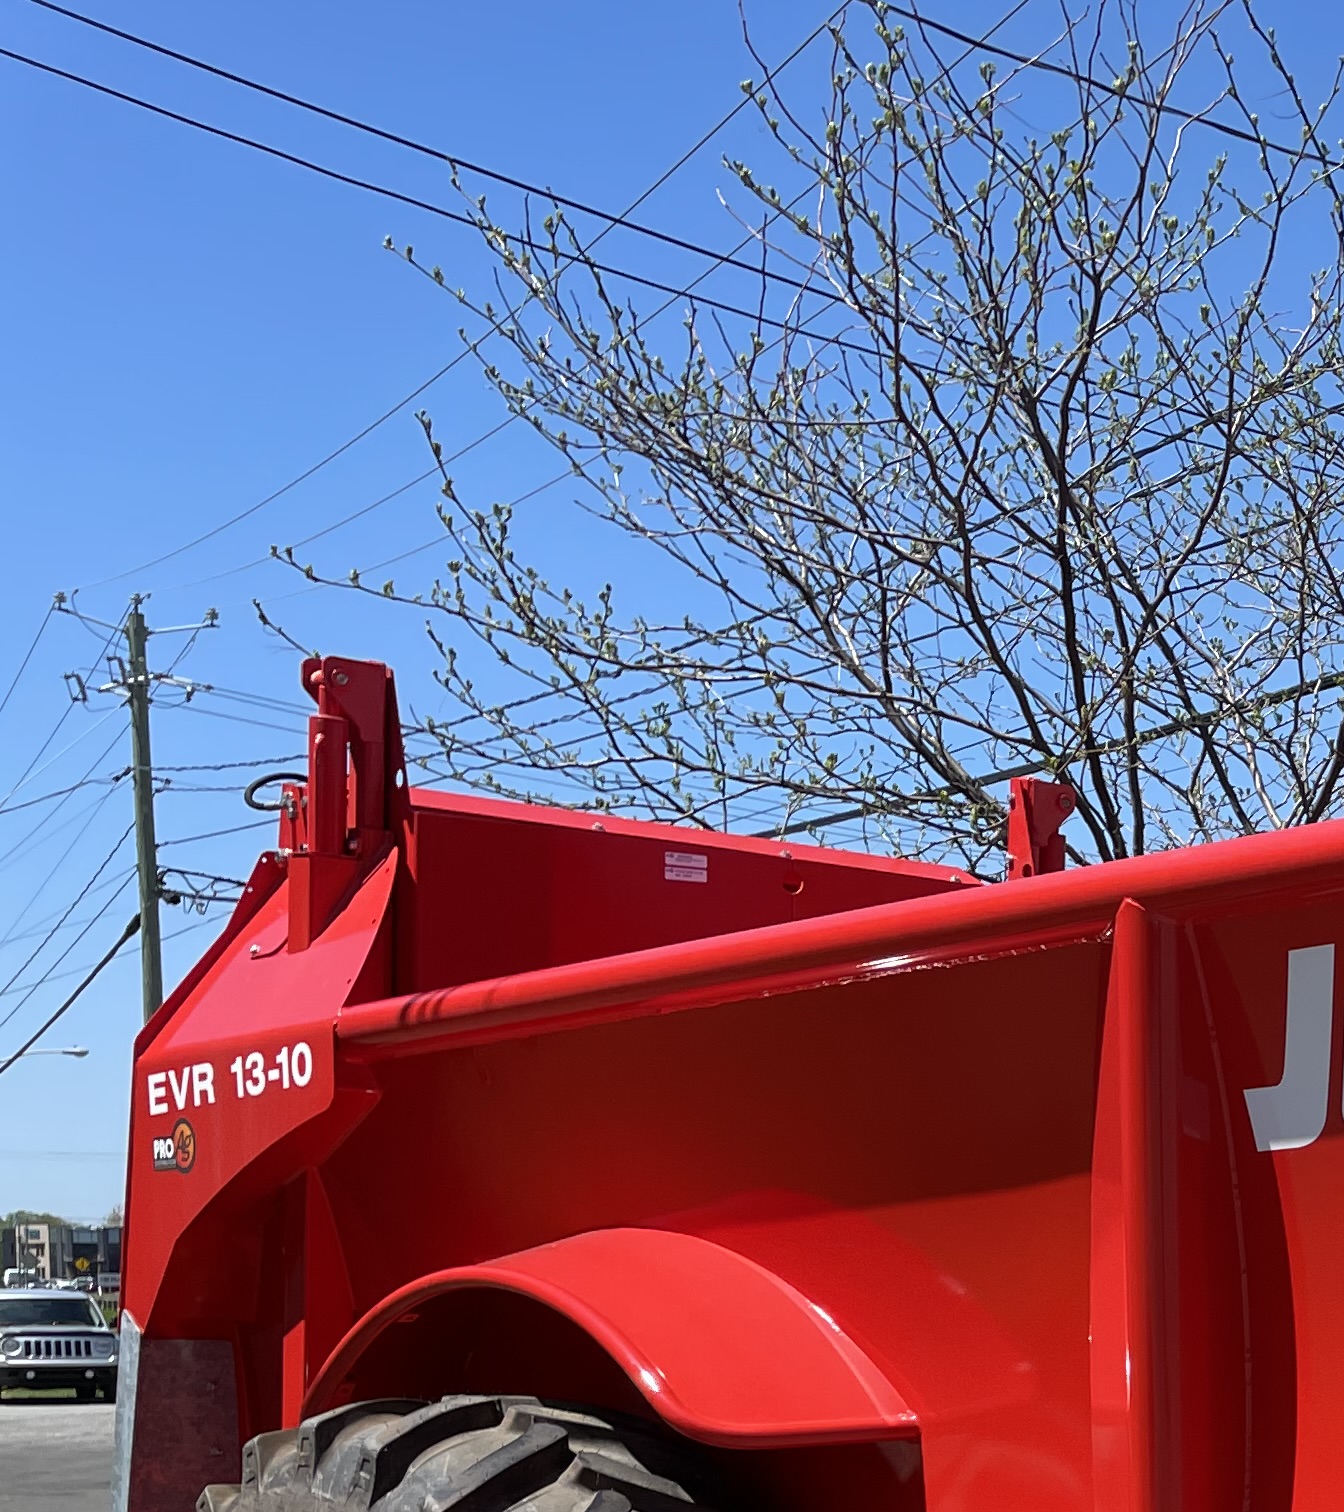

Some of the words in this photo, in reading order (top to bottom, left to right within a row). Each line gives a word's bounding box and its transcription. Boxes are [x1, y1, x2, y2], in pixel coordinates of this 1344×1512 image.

[147, 1061, 216, 1117] EVR
[230, 1041, 313, 1099] 13-10
[153, 1138, 175, 1160] PRO
